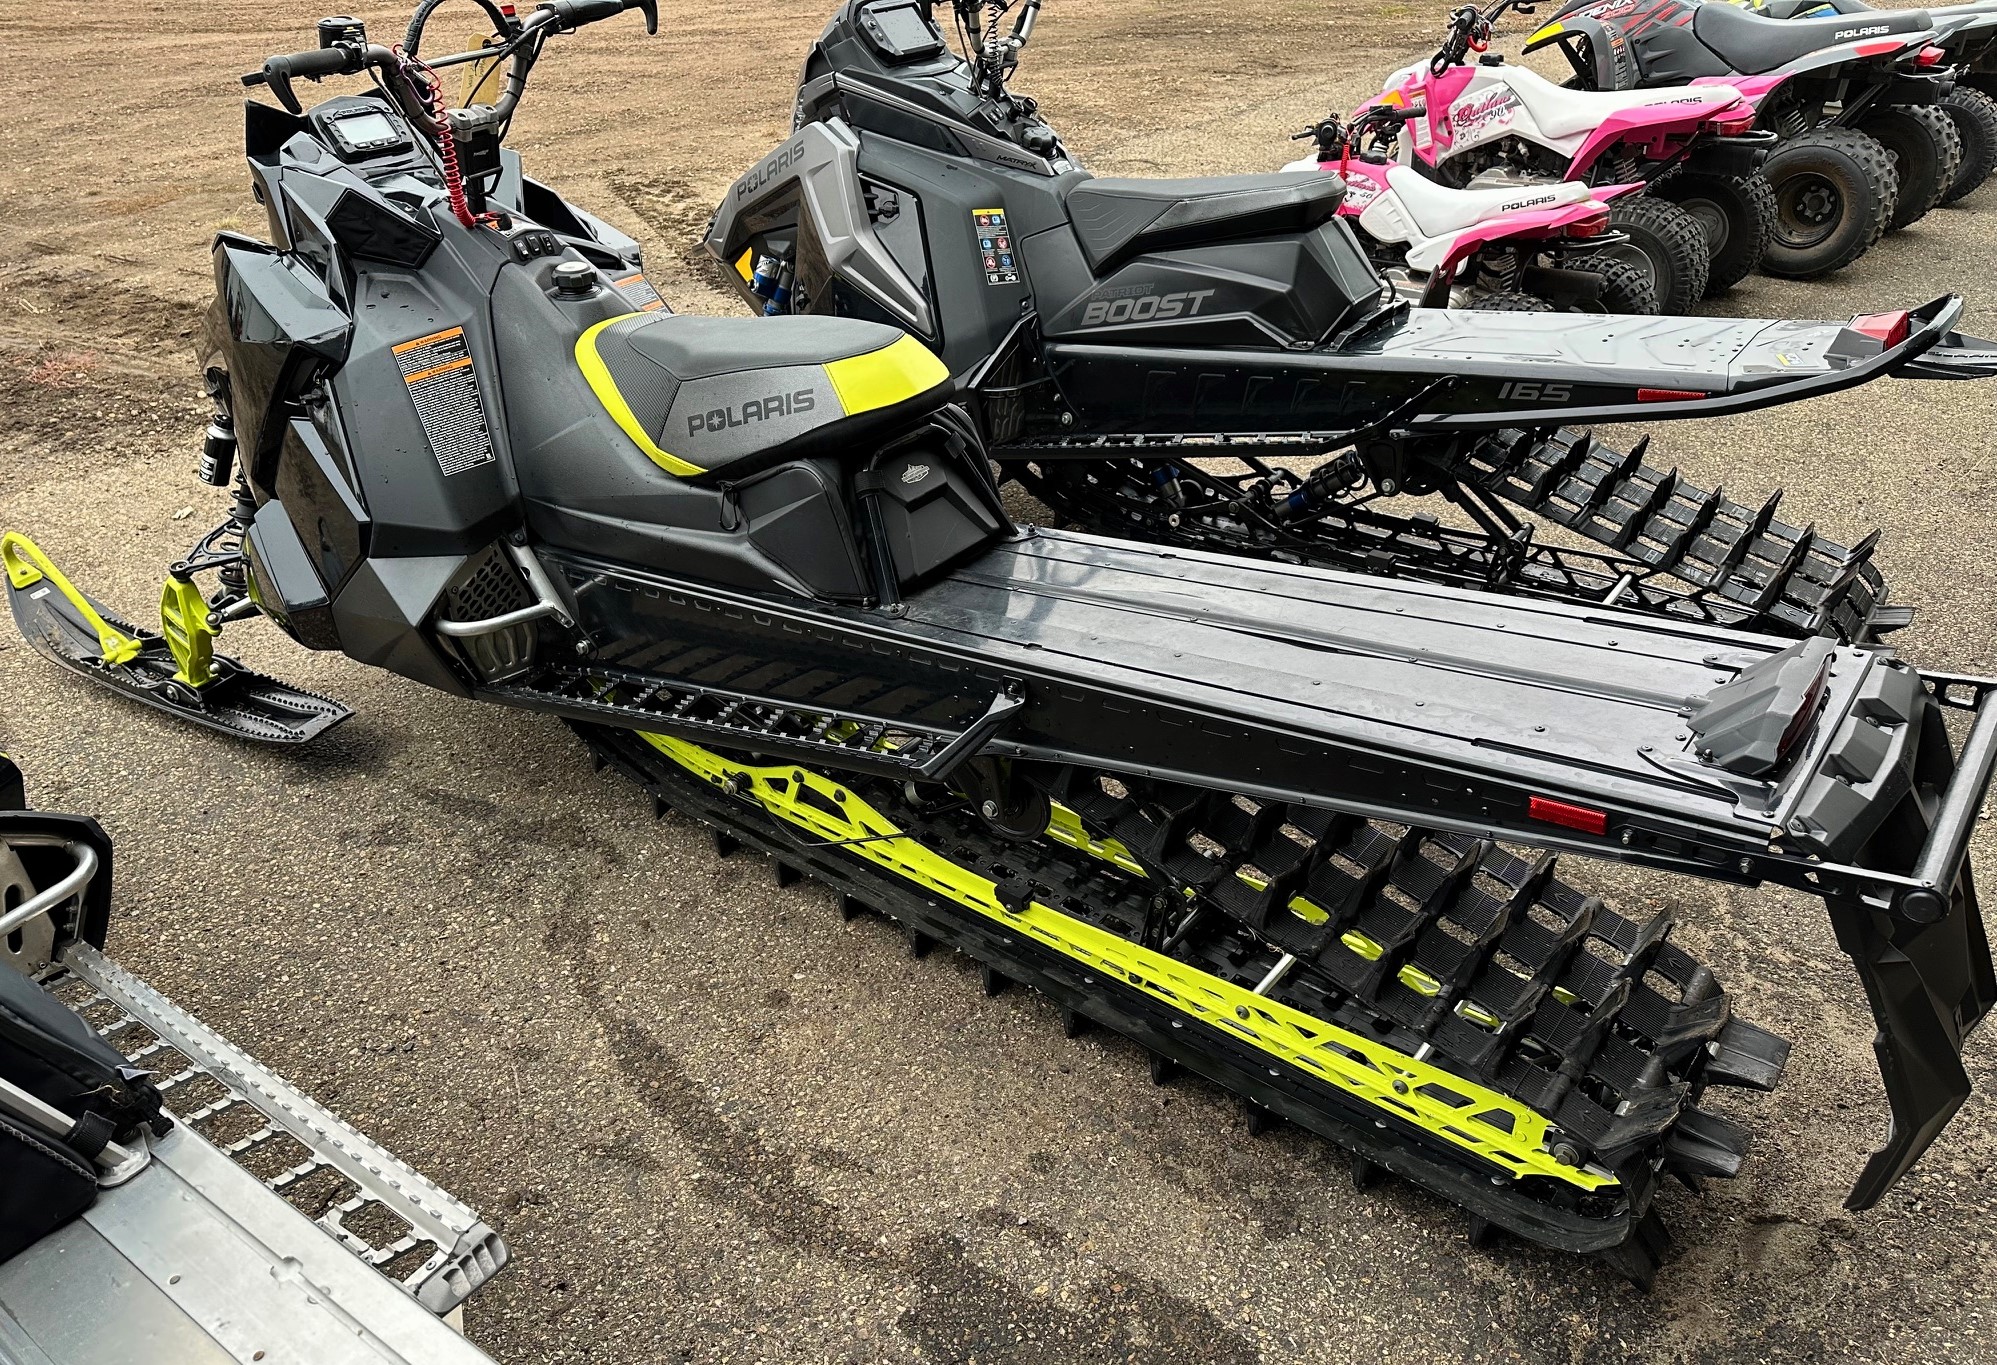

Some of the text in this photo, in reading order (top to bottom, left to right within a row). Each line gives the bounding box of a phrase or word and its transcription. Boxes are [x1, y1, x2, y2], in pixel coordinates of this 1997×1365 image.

[1834, 25, 1890, 40] POLARIS
[736, 139, 805, 202] POLARIS
[996, 154, 1037, 170] MATRYX
[1501, 194, 1556, 212] POLARIS
[1091, 282, 1155, 300] PATRIOT
[1080, 288, 1216, 326] BOOST
[1497, 381, 1574, 402] 165
[687, 388, 815, 437] POLARIS
